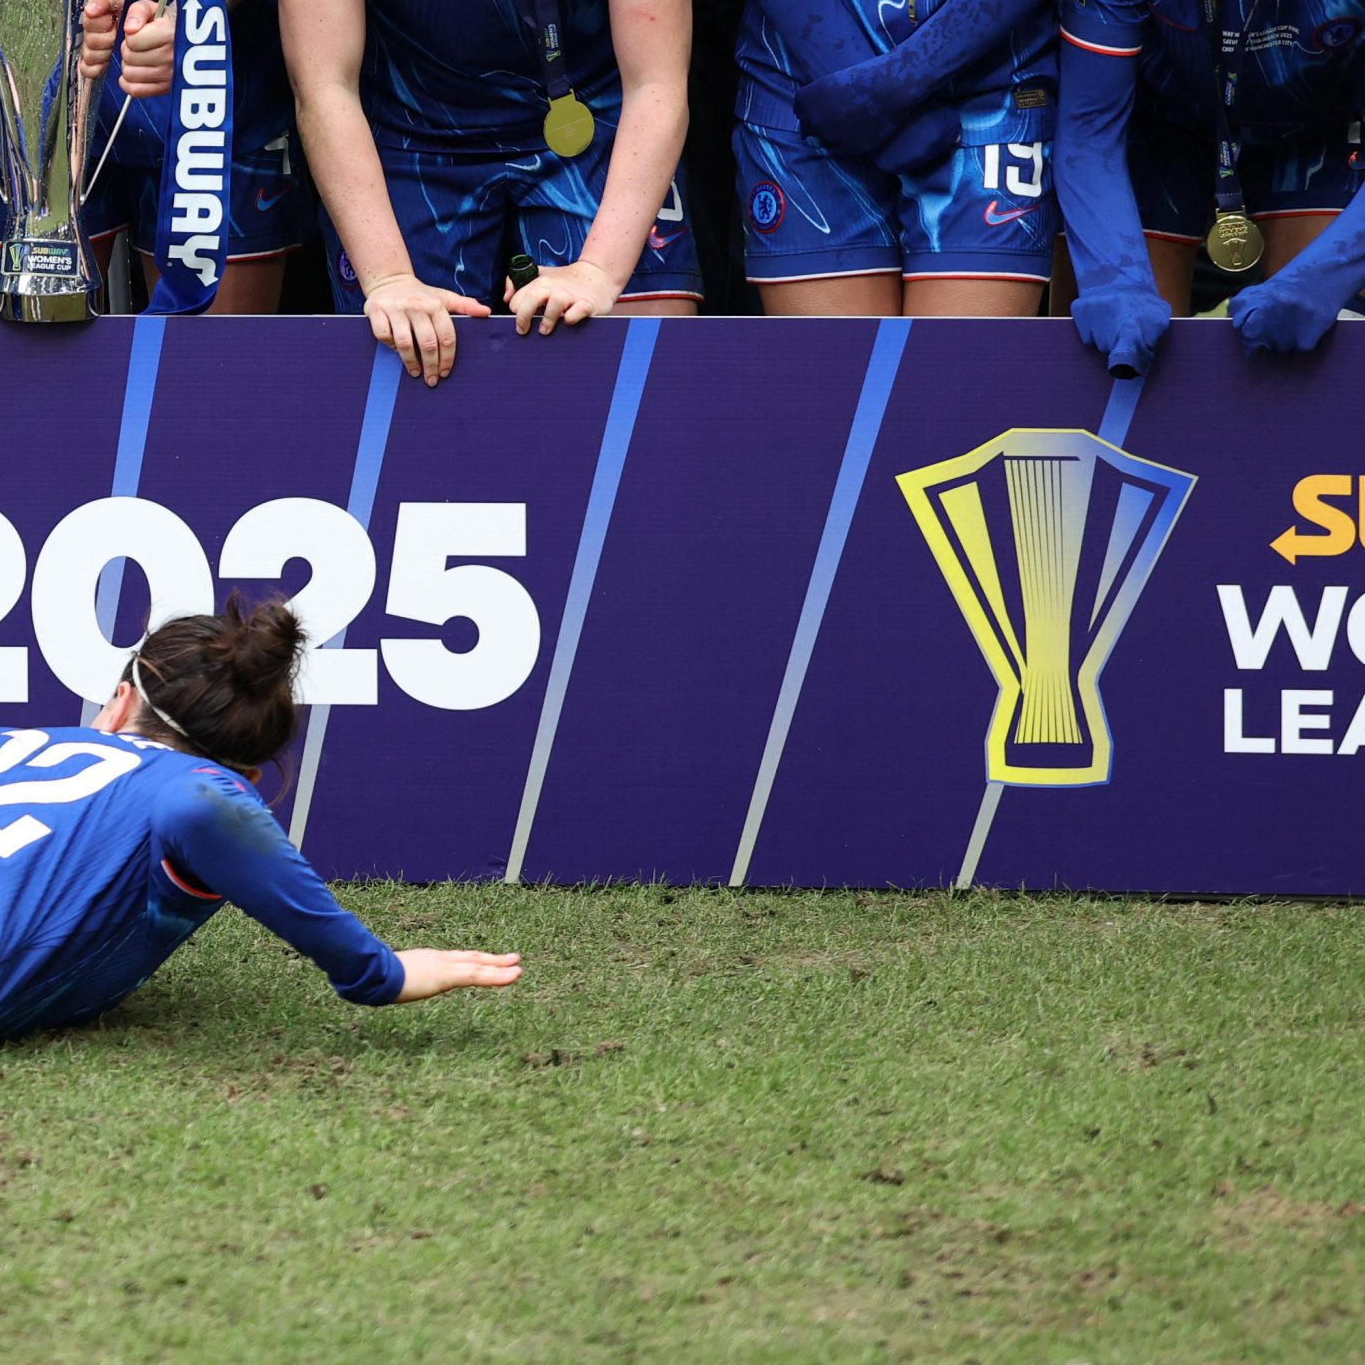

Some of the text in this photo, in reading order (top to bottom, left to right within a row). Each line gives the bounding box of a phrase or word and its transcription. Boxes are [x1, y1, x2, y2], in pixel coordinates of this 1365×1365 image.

[982, 141, 1043, 198] 19
[27, 255, 72, 265] WOMEN'S
[27, 262, 55, 270] LEAGUE
[32, 246, 69, 255] SUBWAY
[1269, 474, 1365, 566] S
[1216, 584, 1365, 671] W
